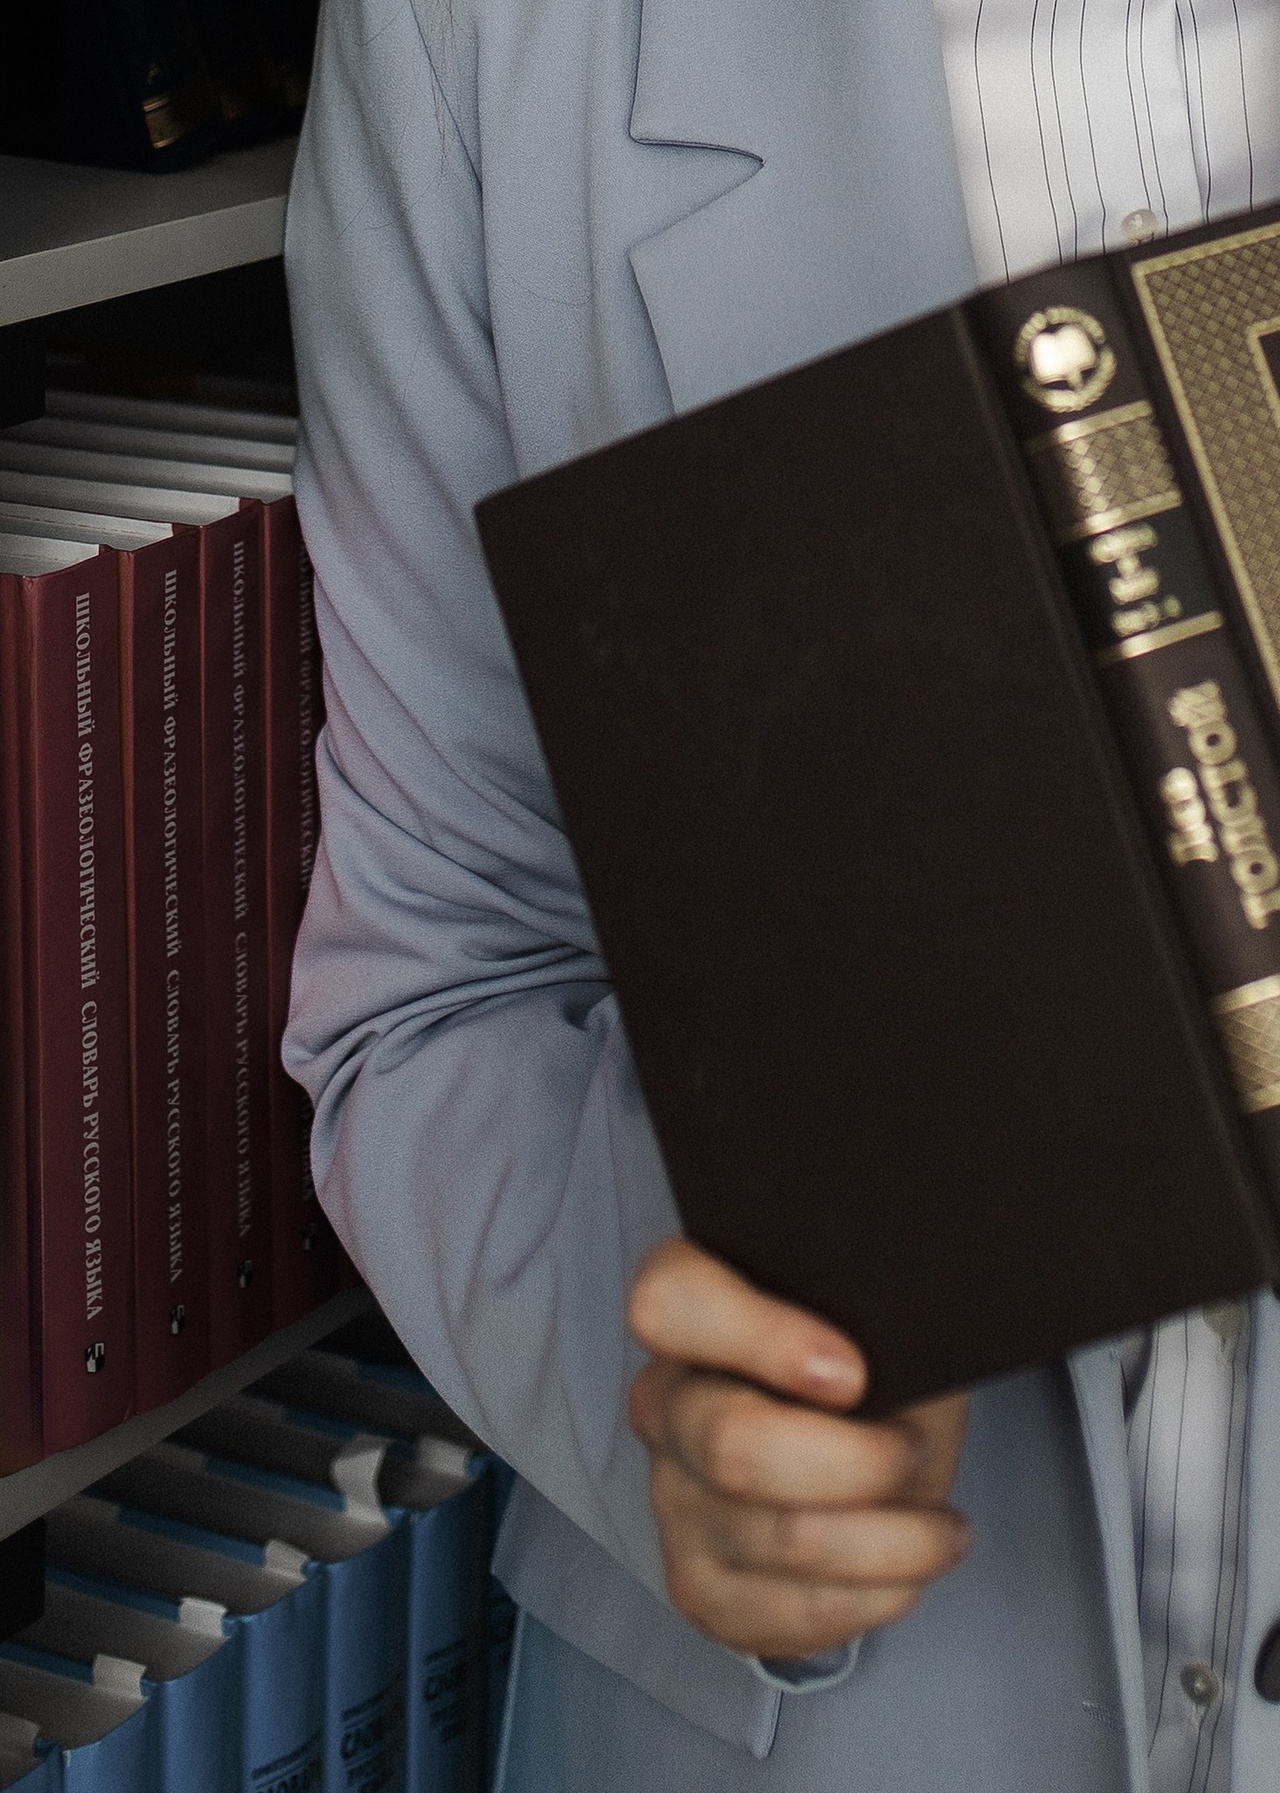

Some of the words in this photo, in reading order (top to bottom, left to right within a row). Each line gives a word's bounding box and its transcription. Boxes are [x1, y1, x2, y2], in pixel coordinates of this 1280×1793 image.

[75, 591, 97, 738] ШКОЛЬНЫЙ
[162, 568, 179, 711] ШКОЛЬНЫЙ
[232, 540, 247, 679] ШКОЛЬНЫЙ
[163, 715, 182, 959] ФРАЗЕОЛОГИЧЕСКИЙ
[233, 683, 249, 921] ФРАЗЕОЛОГИЧЕСКИЙ
[77, 741, 101, 990] ФРАЗЕОЛОГИЧЕСКИЙ
[166, 968, 181, 1075] СЛОВАРЬ
[235, 931, 249, 1035] СЛОВАРЬ
[80, 1000, 100, 1109] СЛОВАРЬ
[236, 1038, 250, 1155] РУССКОГО
[82, 1111, 102, 1234] РУССКОГО
[167, 1077, 182, 1198] РУССКОГО
[238, 1159, 251, 1237] ЯЗЫКА
[84, 1237, 104, 1321] ЯЗЫКА
[168, 1202, 183, 1283] ЯЗЫКА
